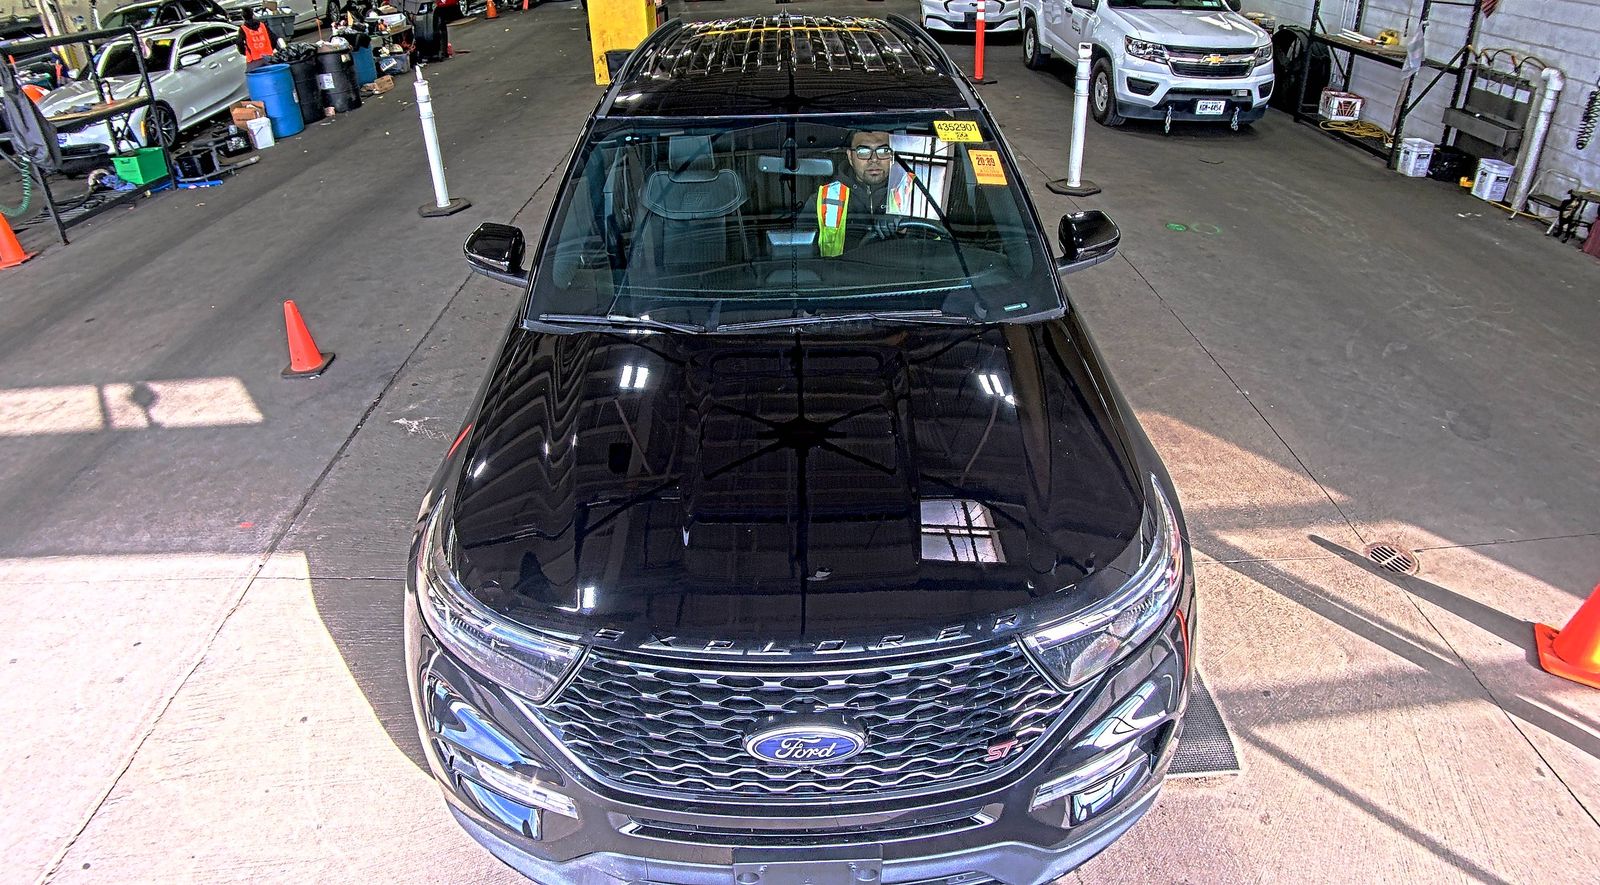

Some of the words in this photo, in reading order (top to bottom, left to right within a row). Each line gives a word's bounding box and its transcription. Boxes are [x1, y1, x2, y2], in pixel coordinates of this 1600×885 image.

[937, 123, 977, 132] 4352901
[594, 613, 1018, 656] EXPLORER
[775, 736, 837, 759] Ford
[983, 739, 1020, 762] ST
